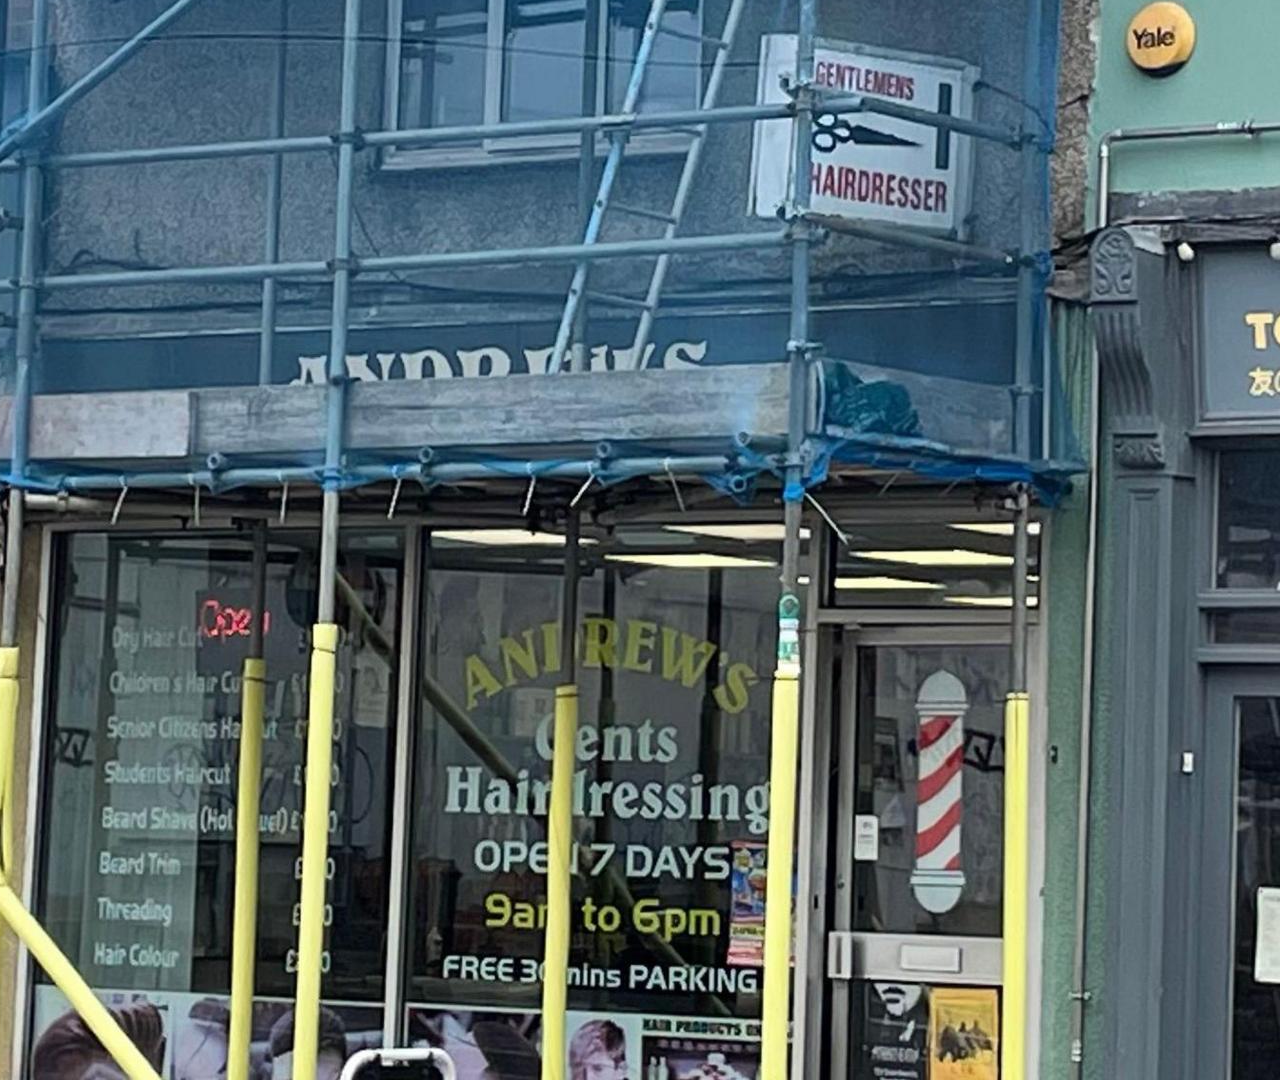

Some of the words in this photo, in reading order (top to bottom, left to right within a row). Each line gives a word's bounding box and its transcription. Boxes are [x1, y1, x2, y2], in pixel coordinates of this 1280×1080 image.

[1132, 26, 1176, 50] Yale
[815, 60, 915, 101] GENTLEMENS
[809, 161, 948, 213] HAIRDRESSER
[186, 671, 219, 694] Hair
[221, 671, 242, 694] Cu
[106, 716, 156, 740] Senior
[158, 717, 217, 741] Citizens
[220, 716, 278, 740] Haut
[104, 760, 171, 785] Students
[174, 762, 231, 785] Haircut
[101, 806, 147, 831] Beard
[99, 851, 144, 876] Beard
[147, 852, 182, 877] Trim
[590, 842, 617, 877] 7
[625, 844, 730, 881] DAYS
[96, 896, 173, 928] Threading
[581, 896, 622, 933] to
[632, 898, 721, 943] 6pm
[93, 941, 127, 967] Hair
[129, 942, 180, 969] Colour
[442, 955, 515, 983] FREE
[628, 964, 758, 994] PARKING
